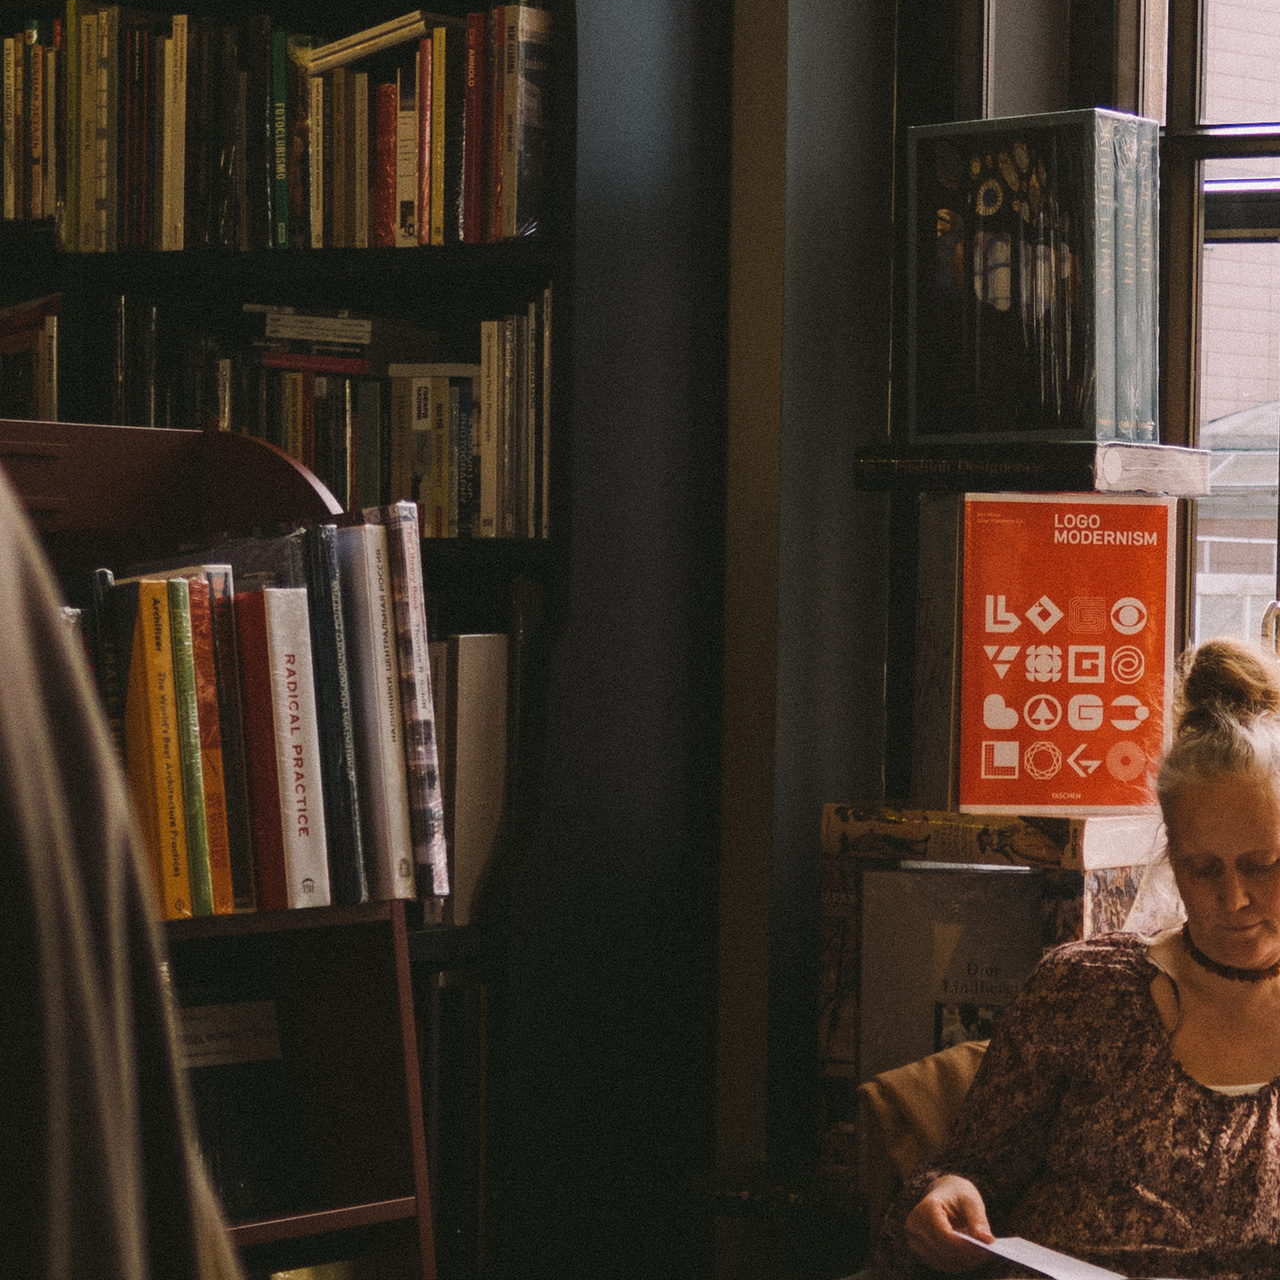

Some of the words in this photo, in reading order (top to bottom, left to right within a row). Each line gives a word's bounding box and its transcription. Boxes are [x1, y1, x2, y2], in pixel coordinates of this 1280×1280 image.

[1053, 513, 1101, 529] LOGO
[1053, 530, 1157, 546] MODERNISM
[152, 597, 165, 653] Architizer
[284, 653, 301, 736] RADICAL
[162, 736, 173, 760] Best
[165, 762, 178, 828] Architecture
[291, 744, 309, 838] PRACTICE
[170, 830, 181, 878] Practices
